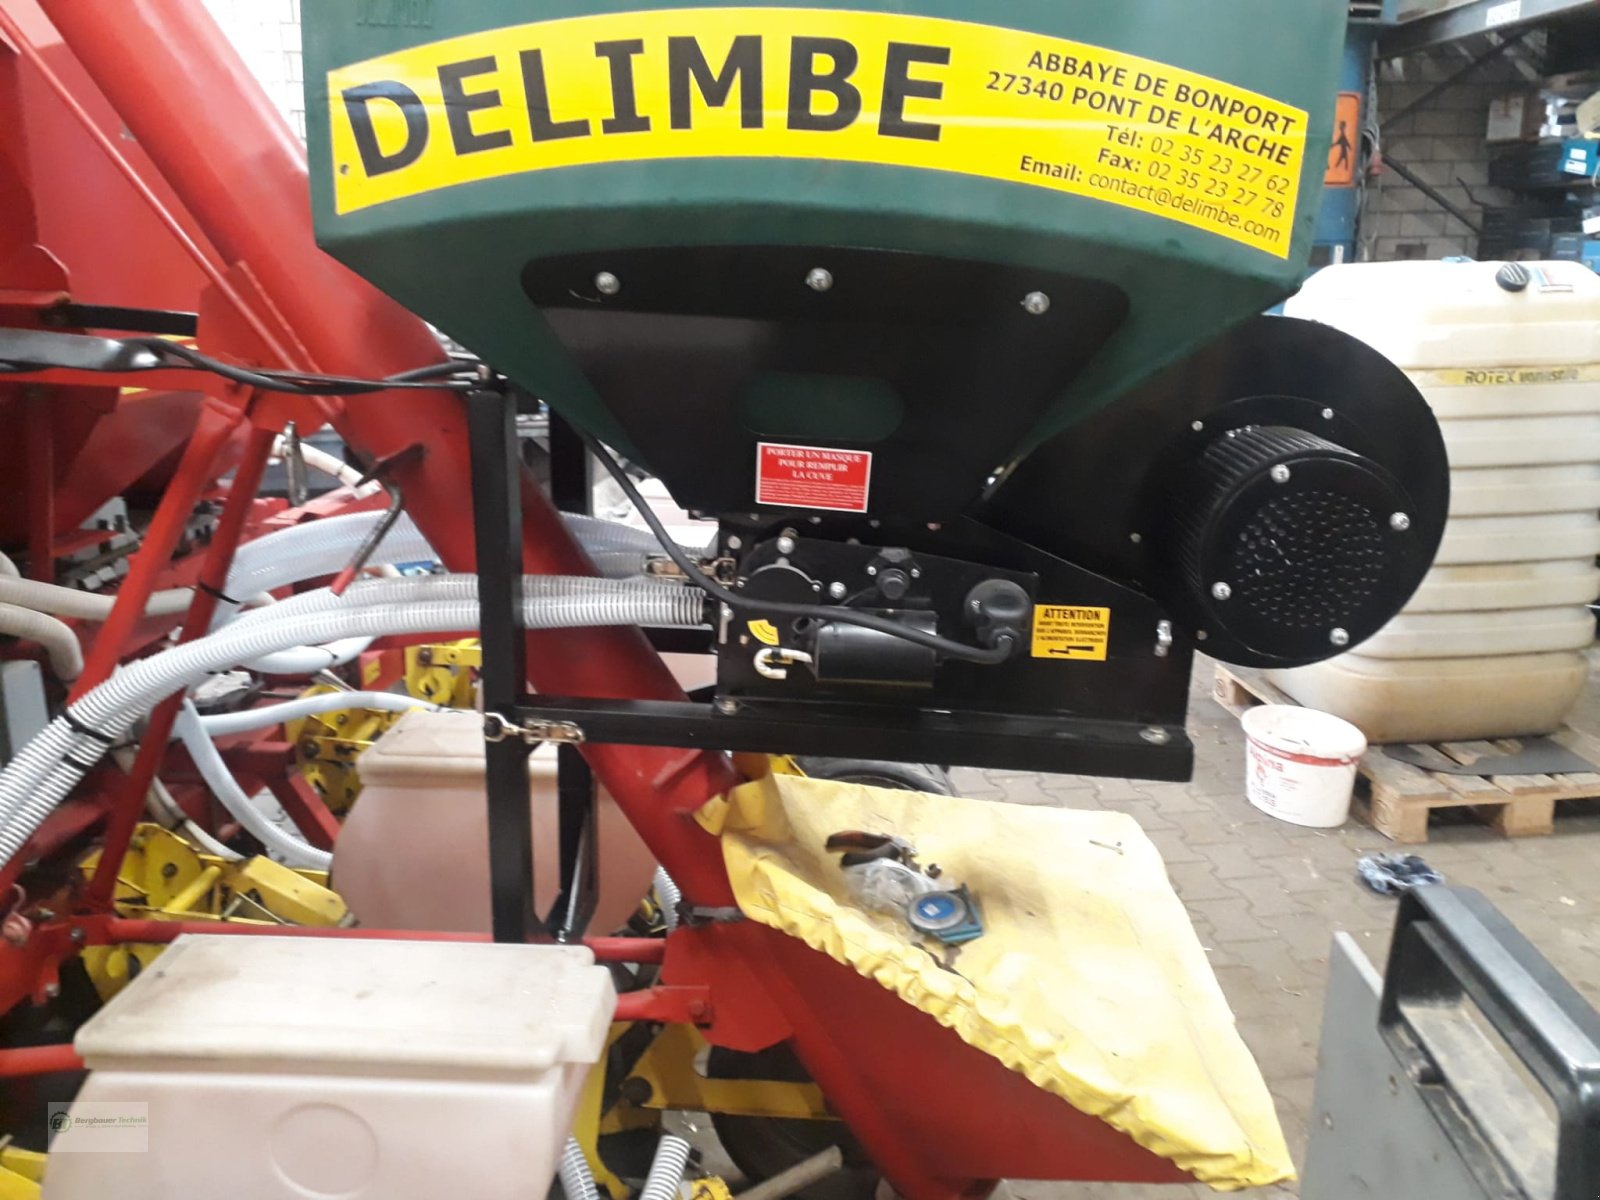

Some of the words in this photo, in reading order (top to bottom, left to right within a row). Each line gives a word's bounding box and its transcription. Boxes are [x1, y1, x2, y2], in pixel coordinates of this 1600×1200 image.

[341, 35, 951, 178] DELIMBE
[986, 71, 1064, 101] 27340
[1072, 87, 1142, 119] PONT
[1148, 106, 1182, 129] DE
[1027, 50, 1127, 87] ABBAYE
[1134, 73, 1168, 97] DE
[1174, 84, 1296, 136] BONPORT
[1097, 148, 1142, 173] Fax:
[1148, 160, 1169, 181] 02
[1176, 168, 1200, 189] 35
[1204, 178, 1228, 199] 23
[1232, 187, 1257, 208] 27
[1261, 197, 1285, 218] 78
[1106, 125, 1144, 149] Tél:
[1151, 136, 1174, 157] 02
[1179, 143, 1202, 165] 35
[1208, 155, 1232, 175] 23
[1241, 164, 1263, 184] 27
[1266, 174, 1290, 196] 62
[1020, 155, 1083, 183] Email:
[1088, 173, 1280, 244] contact@delimbe.com
[1043, 608, 1100, 620] ATTENTION
